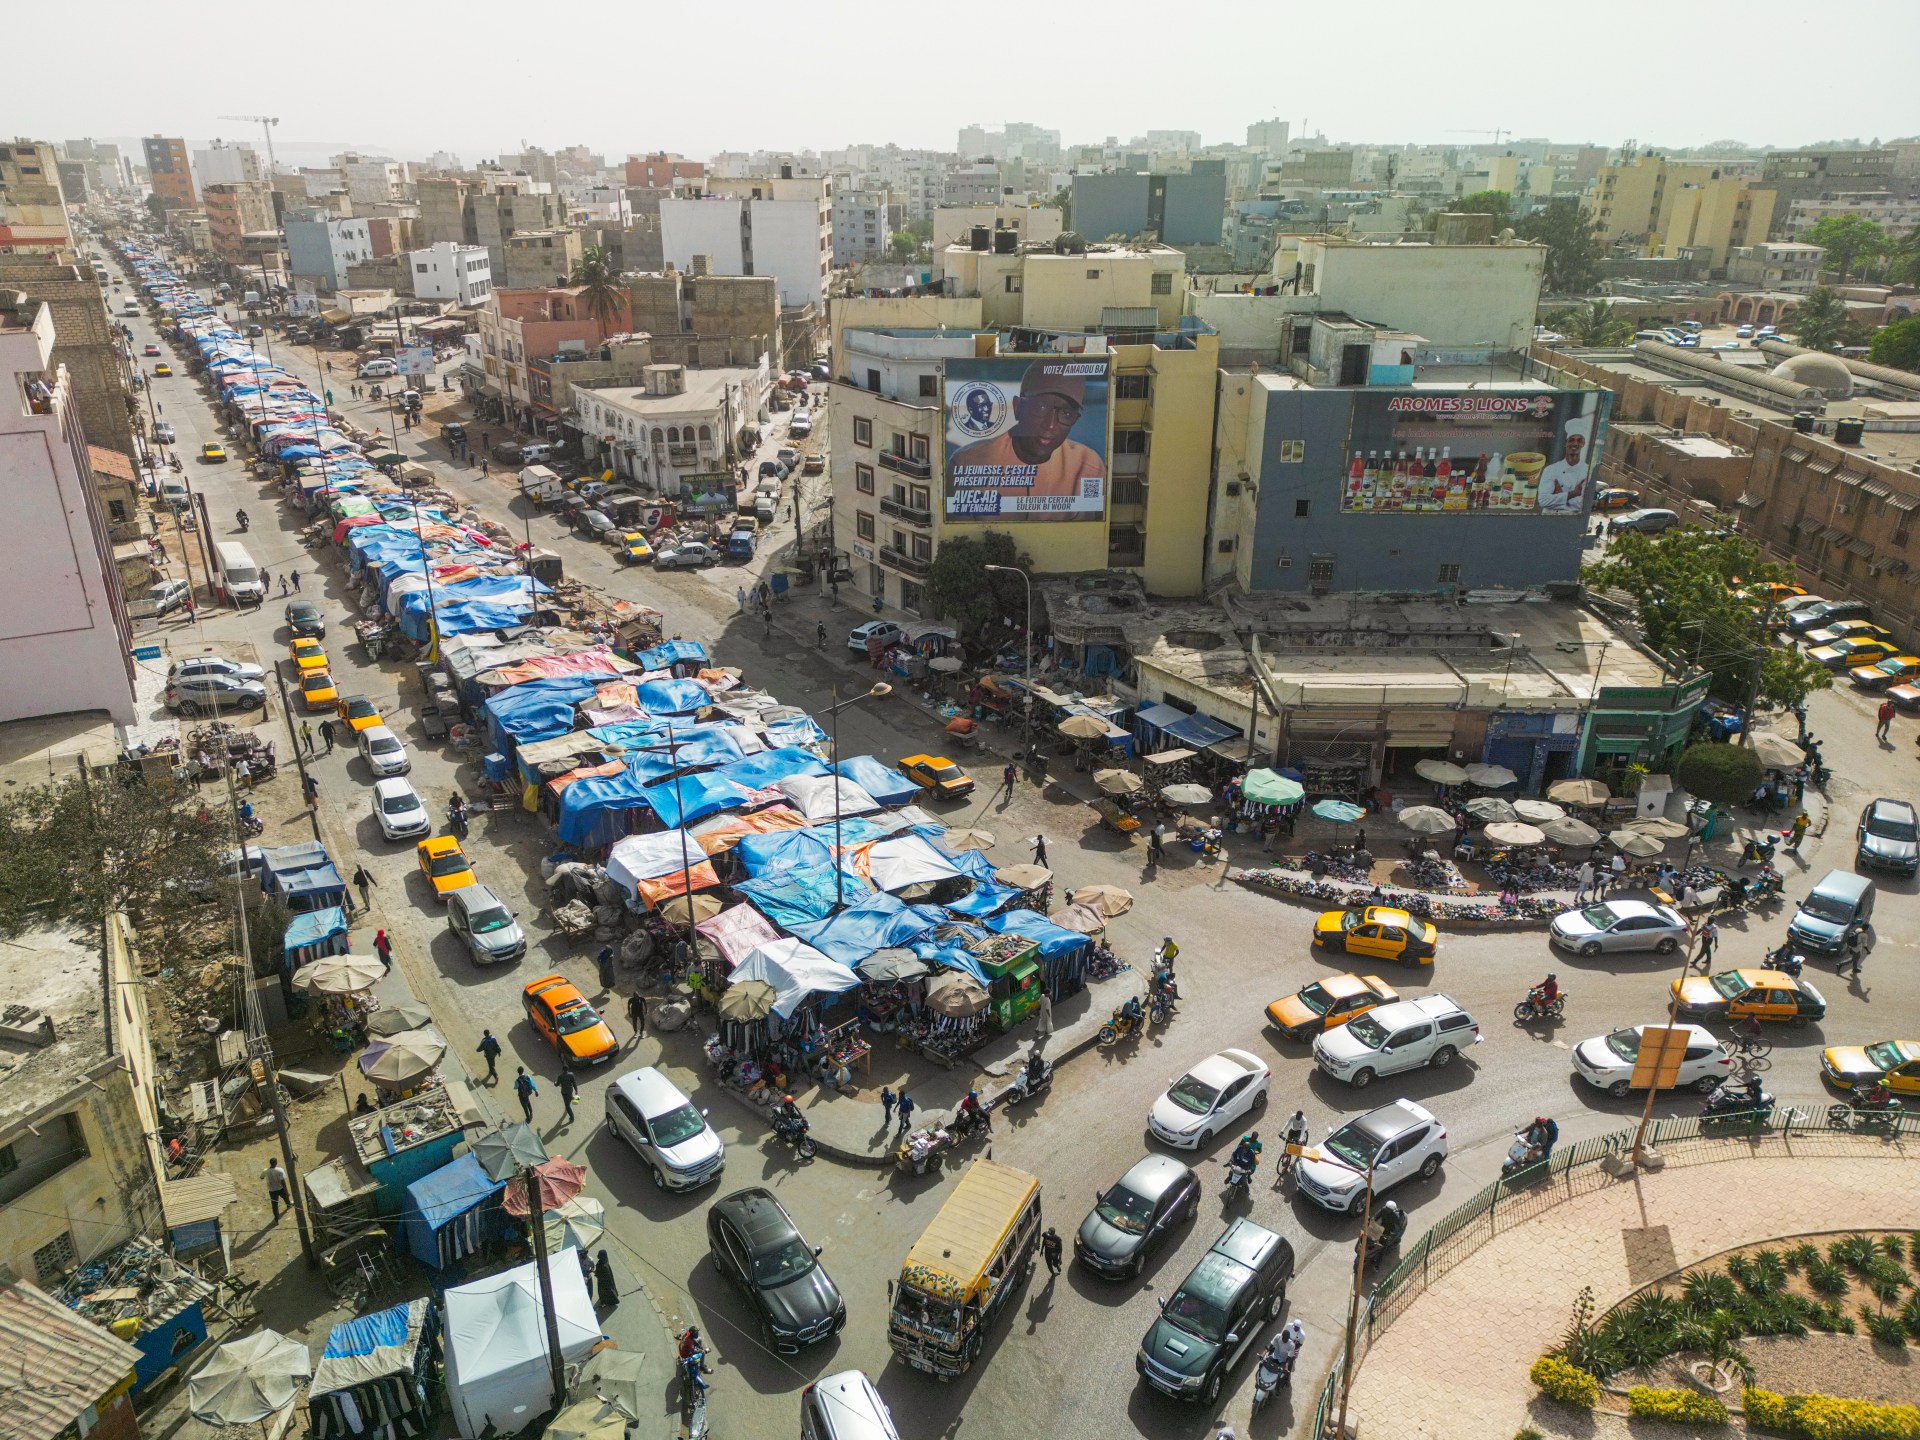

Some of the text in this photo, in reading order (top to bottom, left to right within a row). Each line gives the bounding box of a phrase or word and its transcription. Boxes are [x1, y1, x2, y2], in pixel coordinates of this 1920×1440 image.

[1043, 364, 1105, 375] VOTEZ AMADOU BA
[1388, 397, 1460, 411] AROMES
[1463, 397, 1473, 411] 3
[1475, 397, 1528, 411] LIONS
[953, 464, 1037, 476] LA JEUNESSE, C'EST LE
[953, 475, 1034, 486] PRÉSENT DU SÉNÉGAL
[954, 490, 998, 503] AVEC AB
[961, 503, 998, 512] M'ENGAGE
